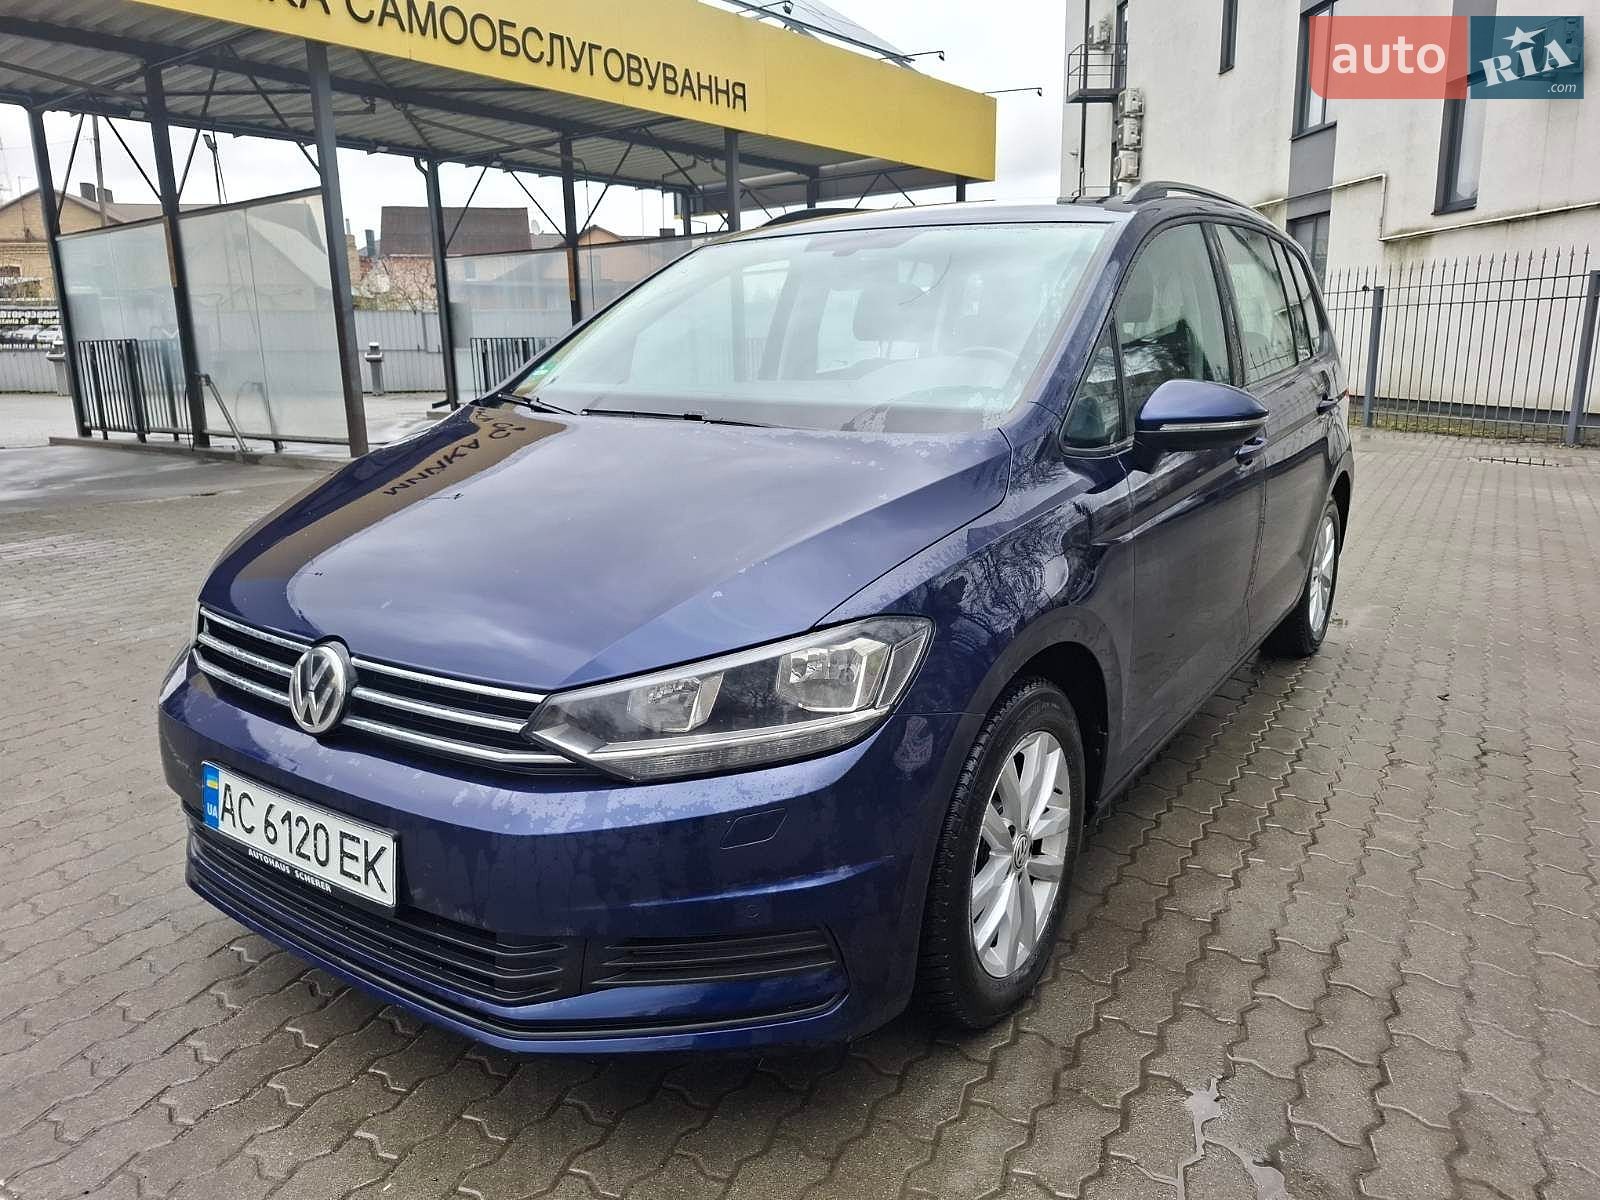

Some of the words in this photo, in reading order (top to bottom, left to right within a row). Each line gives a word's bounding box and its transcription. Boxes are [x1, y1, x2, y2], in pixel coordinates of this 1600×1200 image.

[345, 0, 748, 112] САМООБСЛУГОВУВАННЯ
[206, 802, 219, 818] UA
[220, 782, 256, 835] AC
[263, 803, 330, 868] 6120
[339, 829, 388, 894] EK
[248, 848, 291, 875] AUTOHAUS
[294, 869, 332, 893] SCHERER
